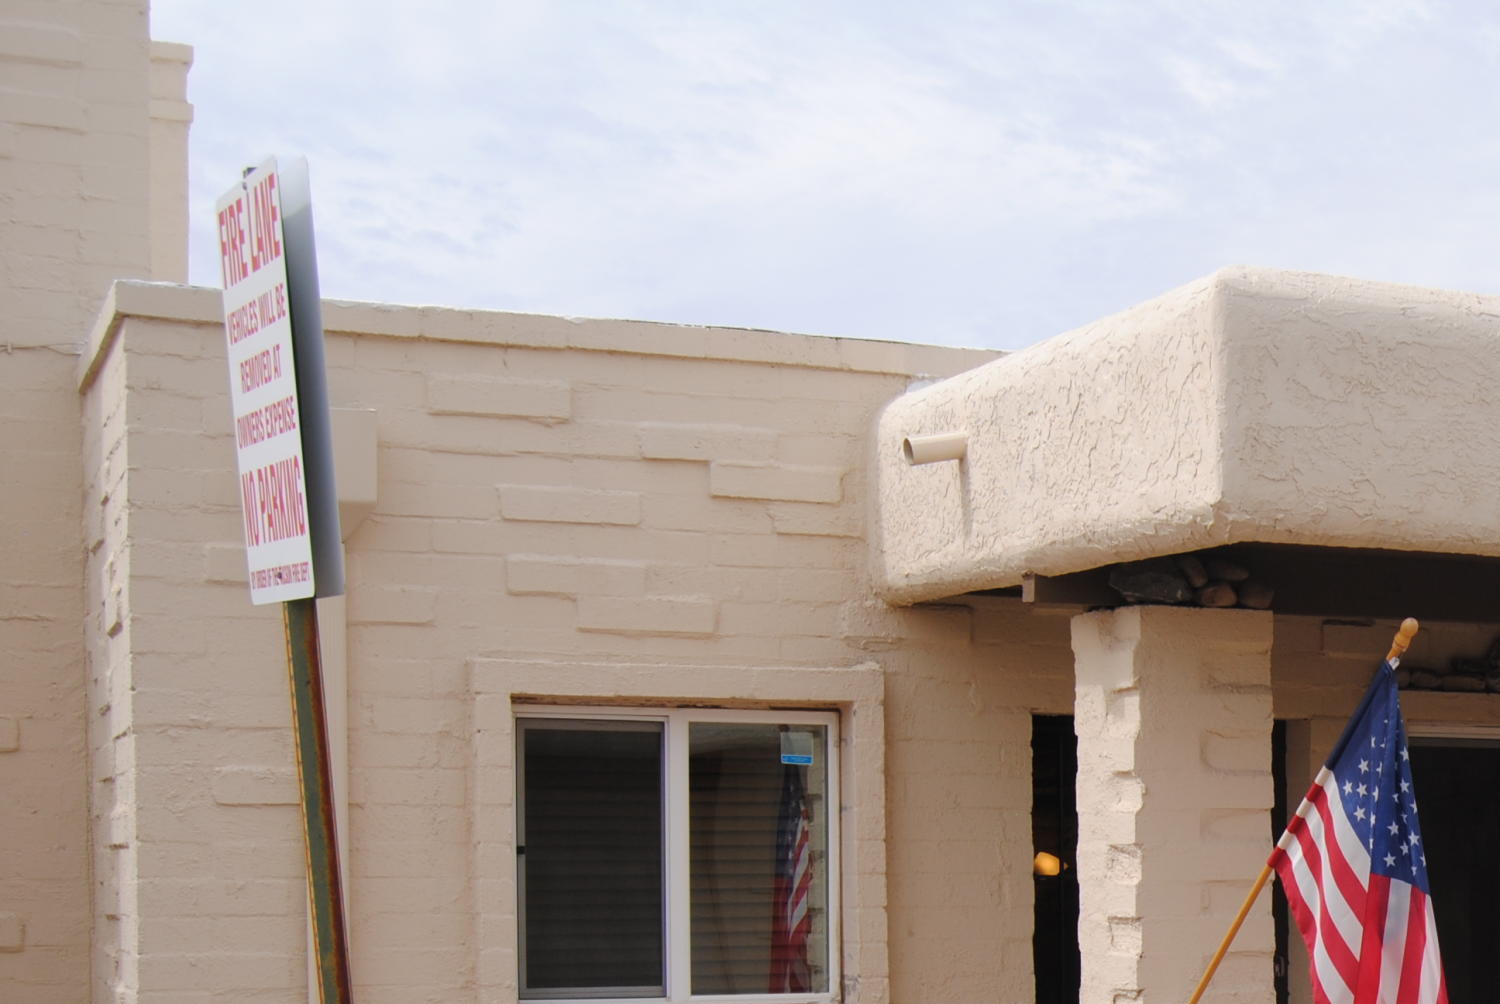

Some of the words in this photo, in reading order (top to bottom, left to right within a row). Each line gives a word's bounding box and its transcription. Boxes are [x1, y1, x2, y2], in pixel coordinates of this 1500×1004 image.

[218, 197, 249, 290] FIRE
[246, 172, 281, 272] LANE
[227, 299, 259, 346] VEHICLES
[258, 289, 276, 329] WILL
[275, 283, 286, 320] BE
[239, 349, 273, 394] REMOVED
[272, 344, 282, 380] AT
[264, 395, 296, 439] EXPENSE
[242, 470, 260, 548] NO
[257, 455, 306, 543] PARKING
